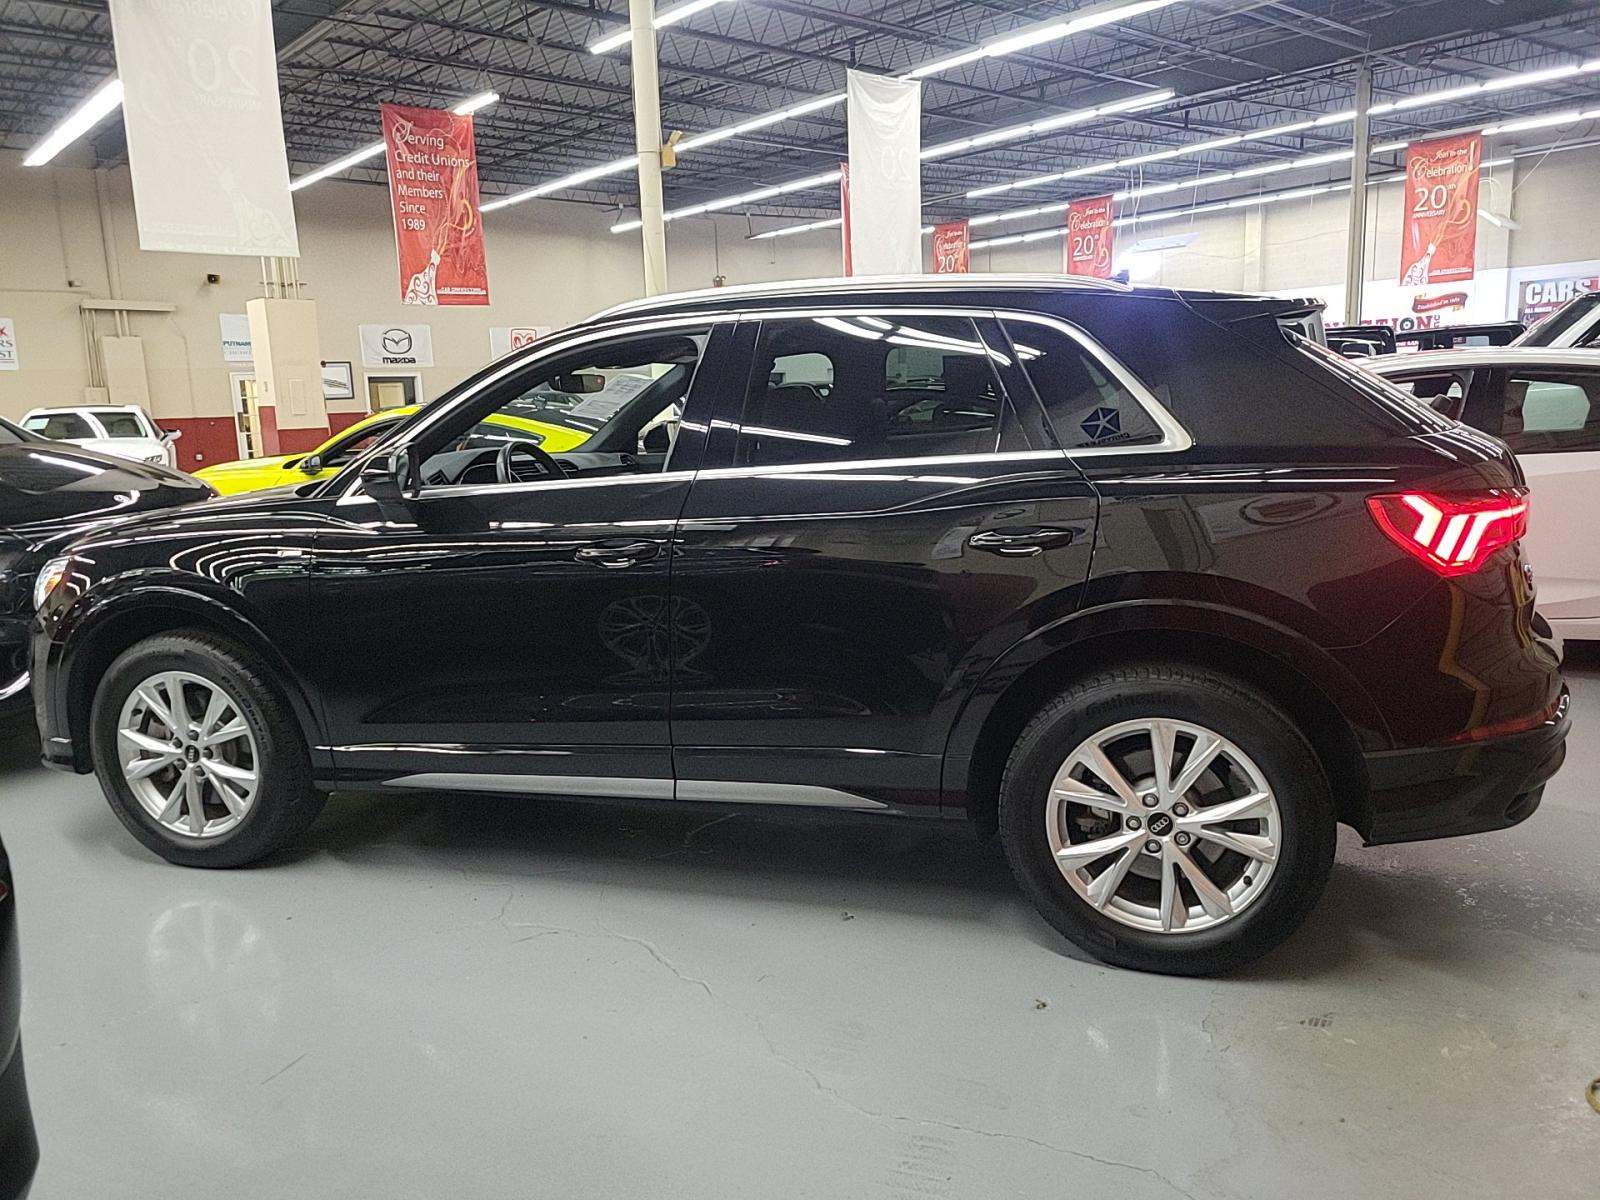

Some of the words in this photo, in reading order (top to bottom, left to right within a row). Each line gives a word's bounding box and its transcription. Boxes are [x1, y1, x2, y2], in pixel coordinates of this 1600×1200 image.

[392, 121, 444, 149] Serving
[395, 150, 431, 165] Credit
[431, 155, 471, 168] Unions
[396, 168, 414, 180] and
[417, 170, 440, 182] their
[398, 184, 444, 199] Members
[400, 200, 426, 214] Since
[401, 218, 426, 231] 1989
[1525, 279, 1591, 305] CARS
